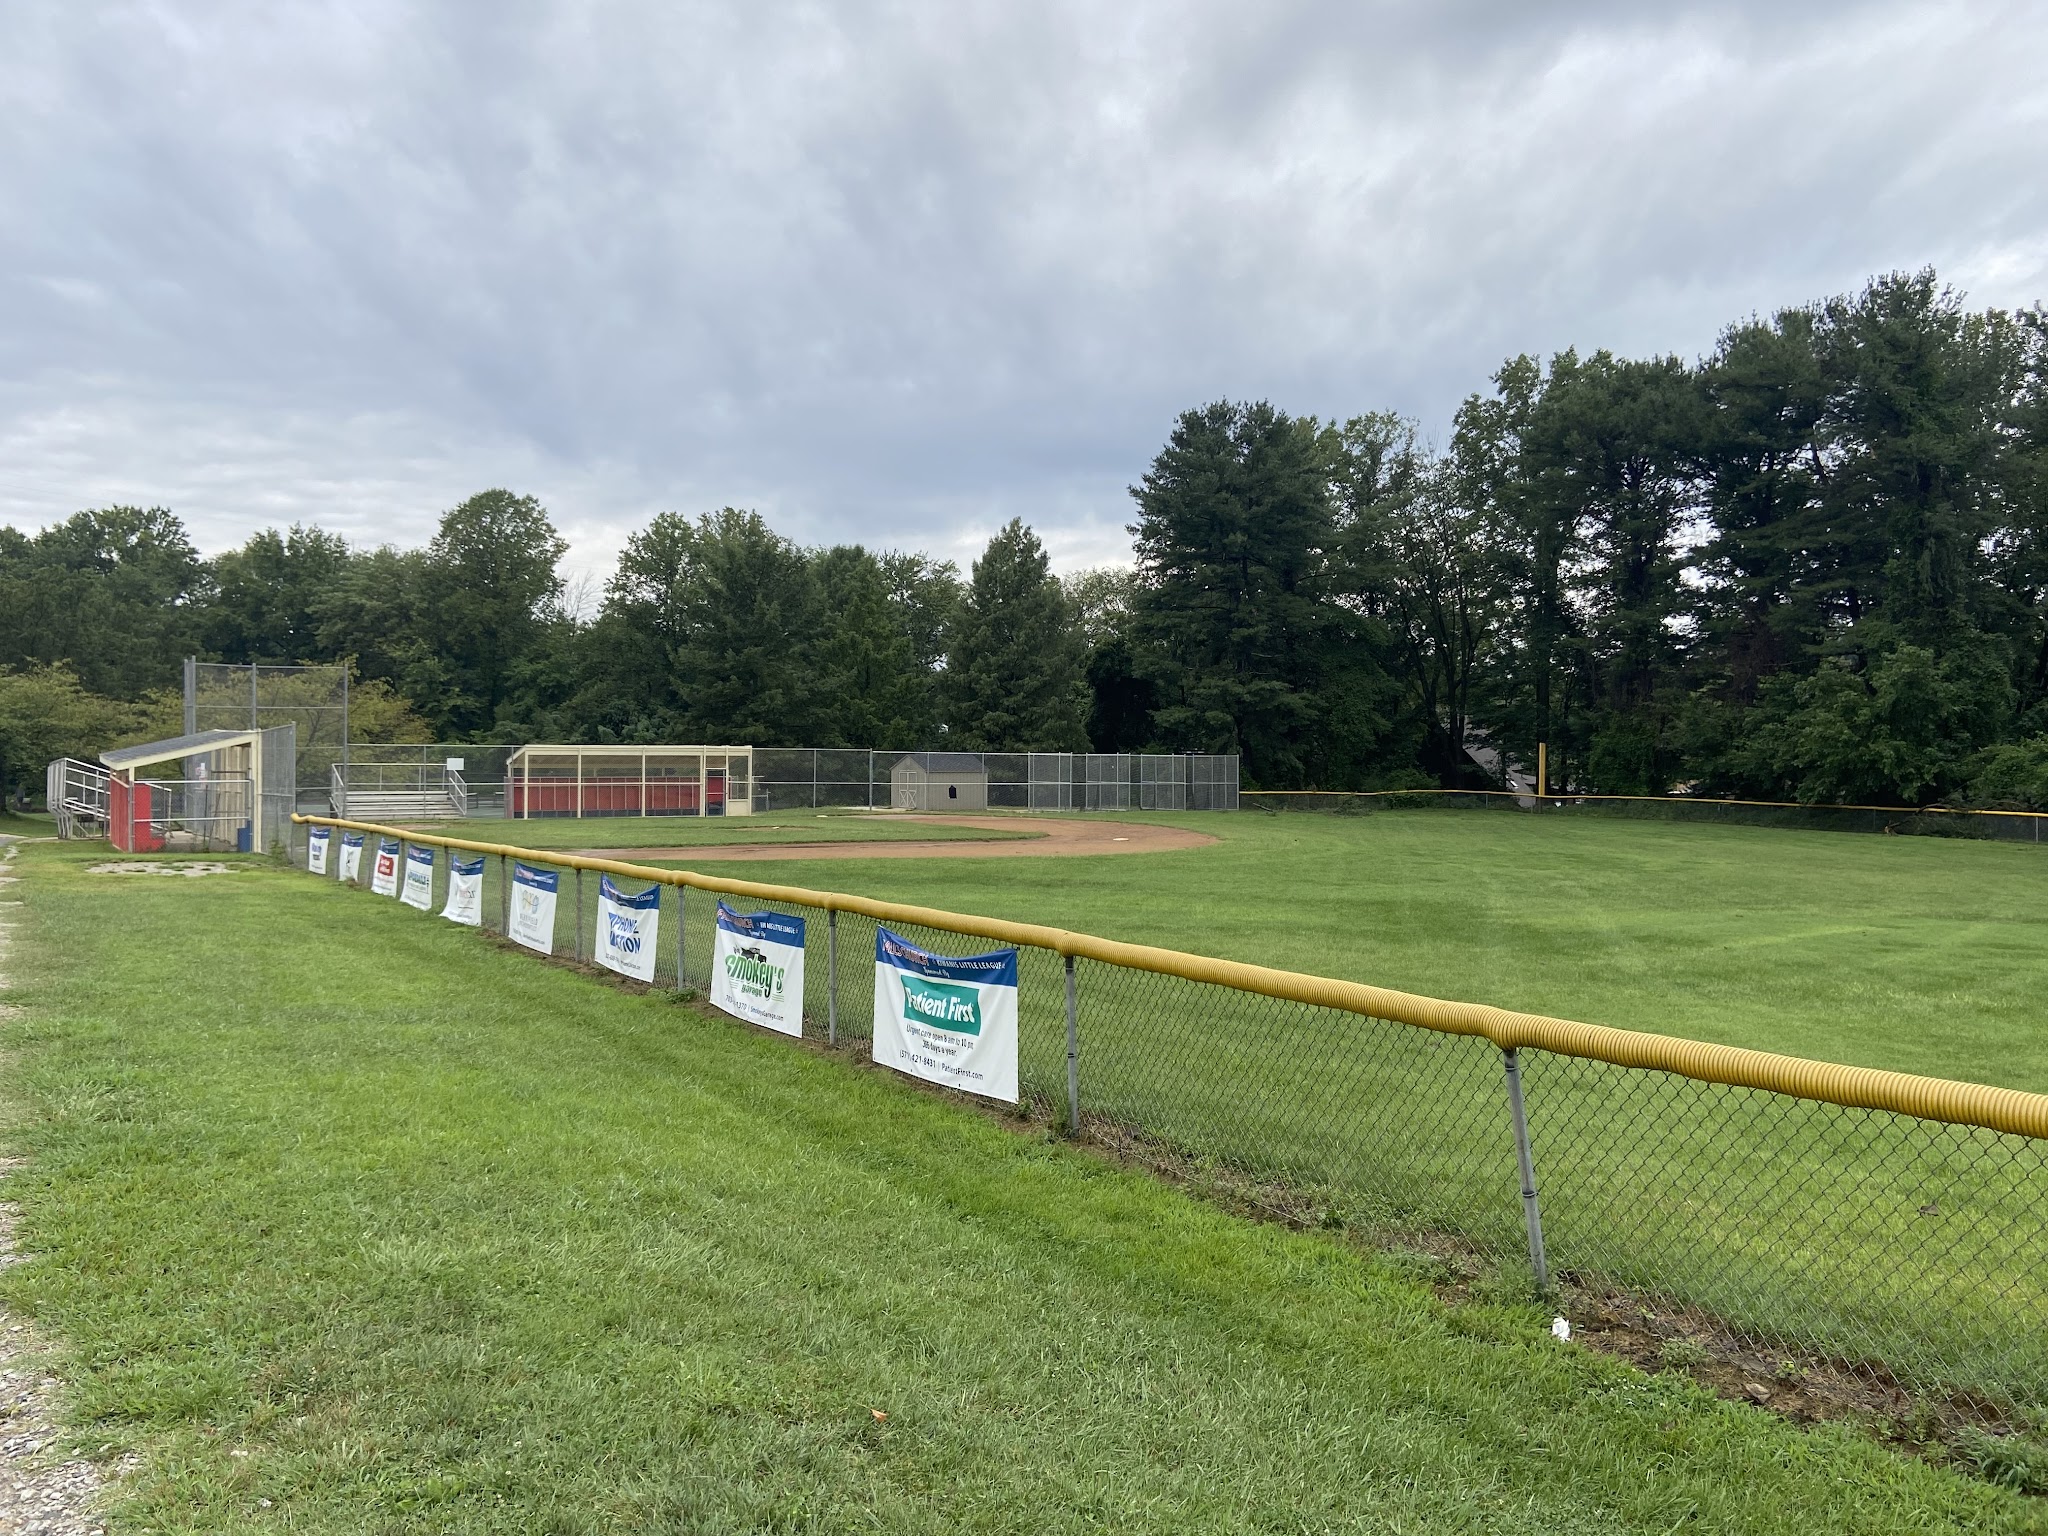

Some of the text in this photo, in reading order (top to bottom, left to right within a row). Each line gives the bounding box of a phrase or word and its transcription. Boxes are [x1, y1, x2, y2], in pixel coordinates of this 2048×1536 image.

[959, 961, 979, 970] LITTLE
[979, 961, 1002, 970] LEAGUE
[905, 986, 976, 1024] Patient First
[906, 1023, 921, 1037] Urgent
[920, 1029, 932, 1041] care
[932, 1033, 944, 1044] open
[930, 1040, 941, 1055] days
[911, 1053, 936, 1069] 421-8431
[941, 1062, 984, 1081] PatientFirst.com
